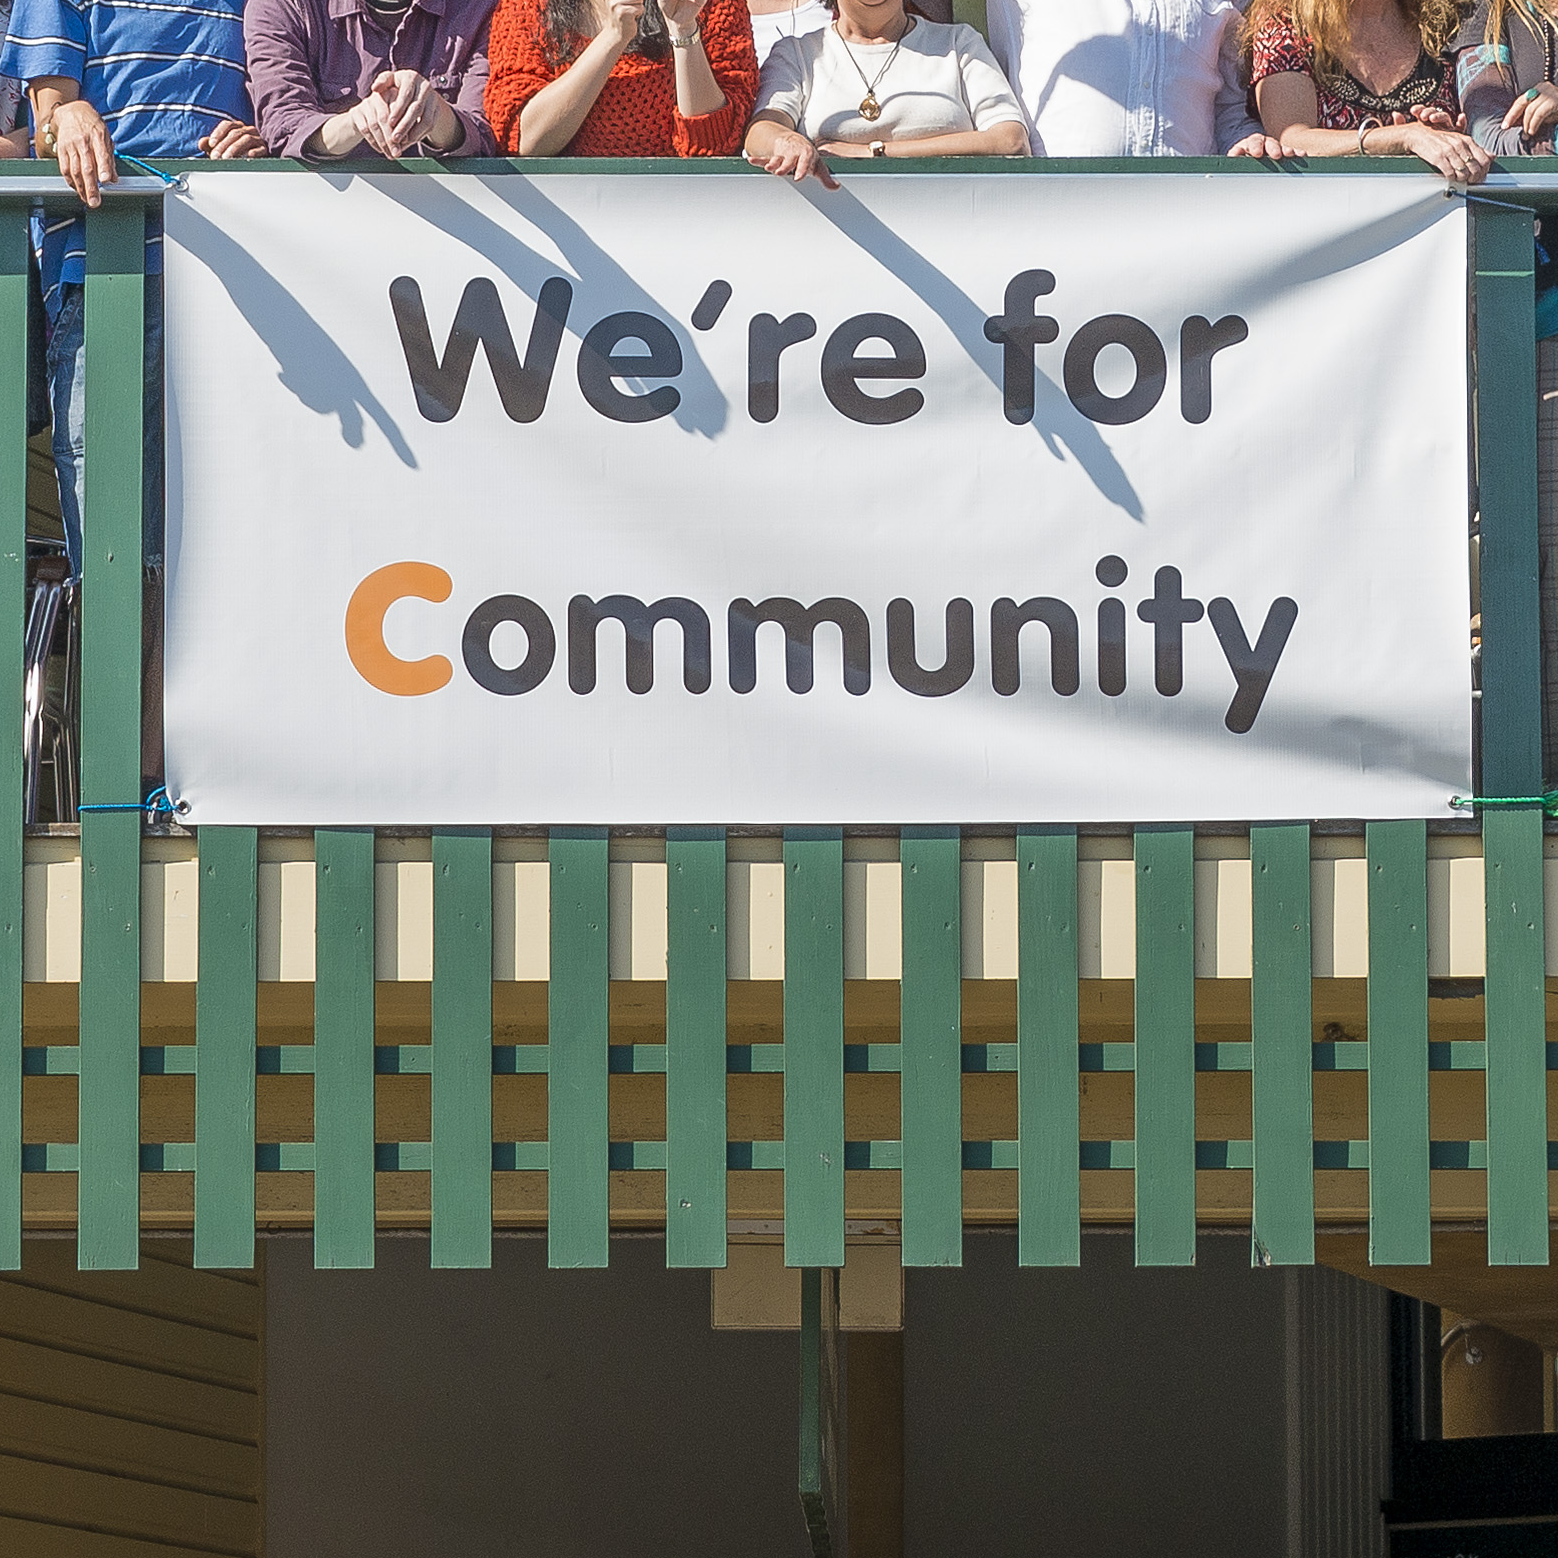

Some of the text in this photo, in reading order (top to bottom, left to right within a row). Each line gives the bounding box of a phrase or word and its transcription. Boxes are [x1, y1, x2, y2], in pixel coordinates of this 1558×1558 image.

[388, 267, 1250, 427] We're for
[344, 553, 1300, 736] Community
